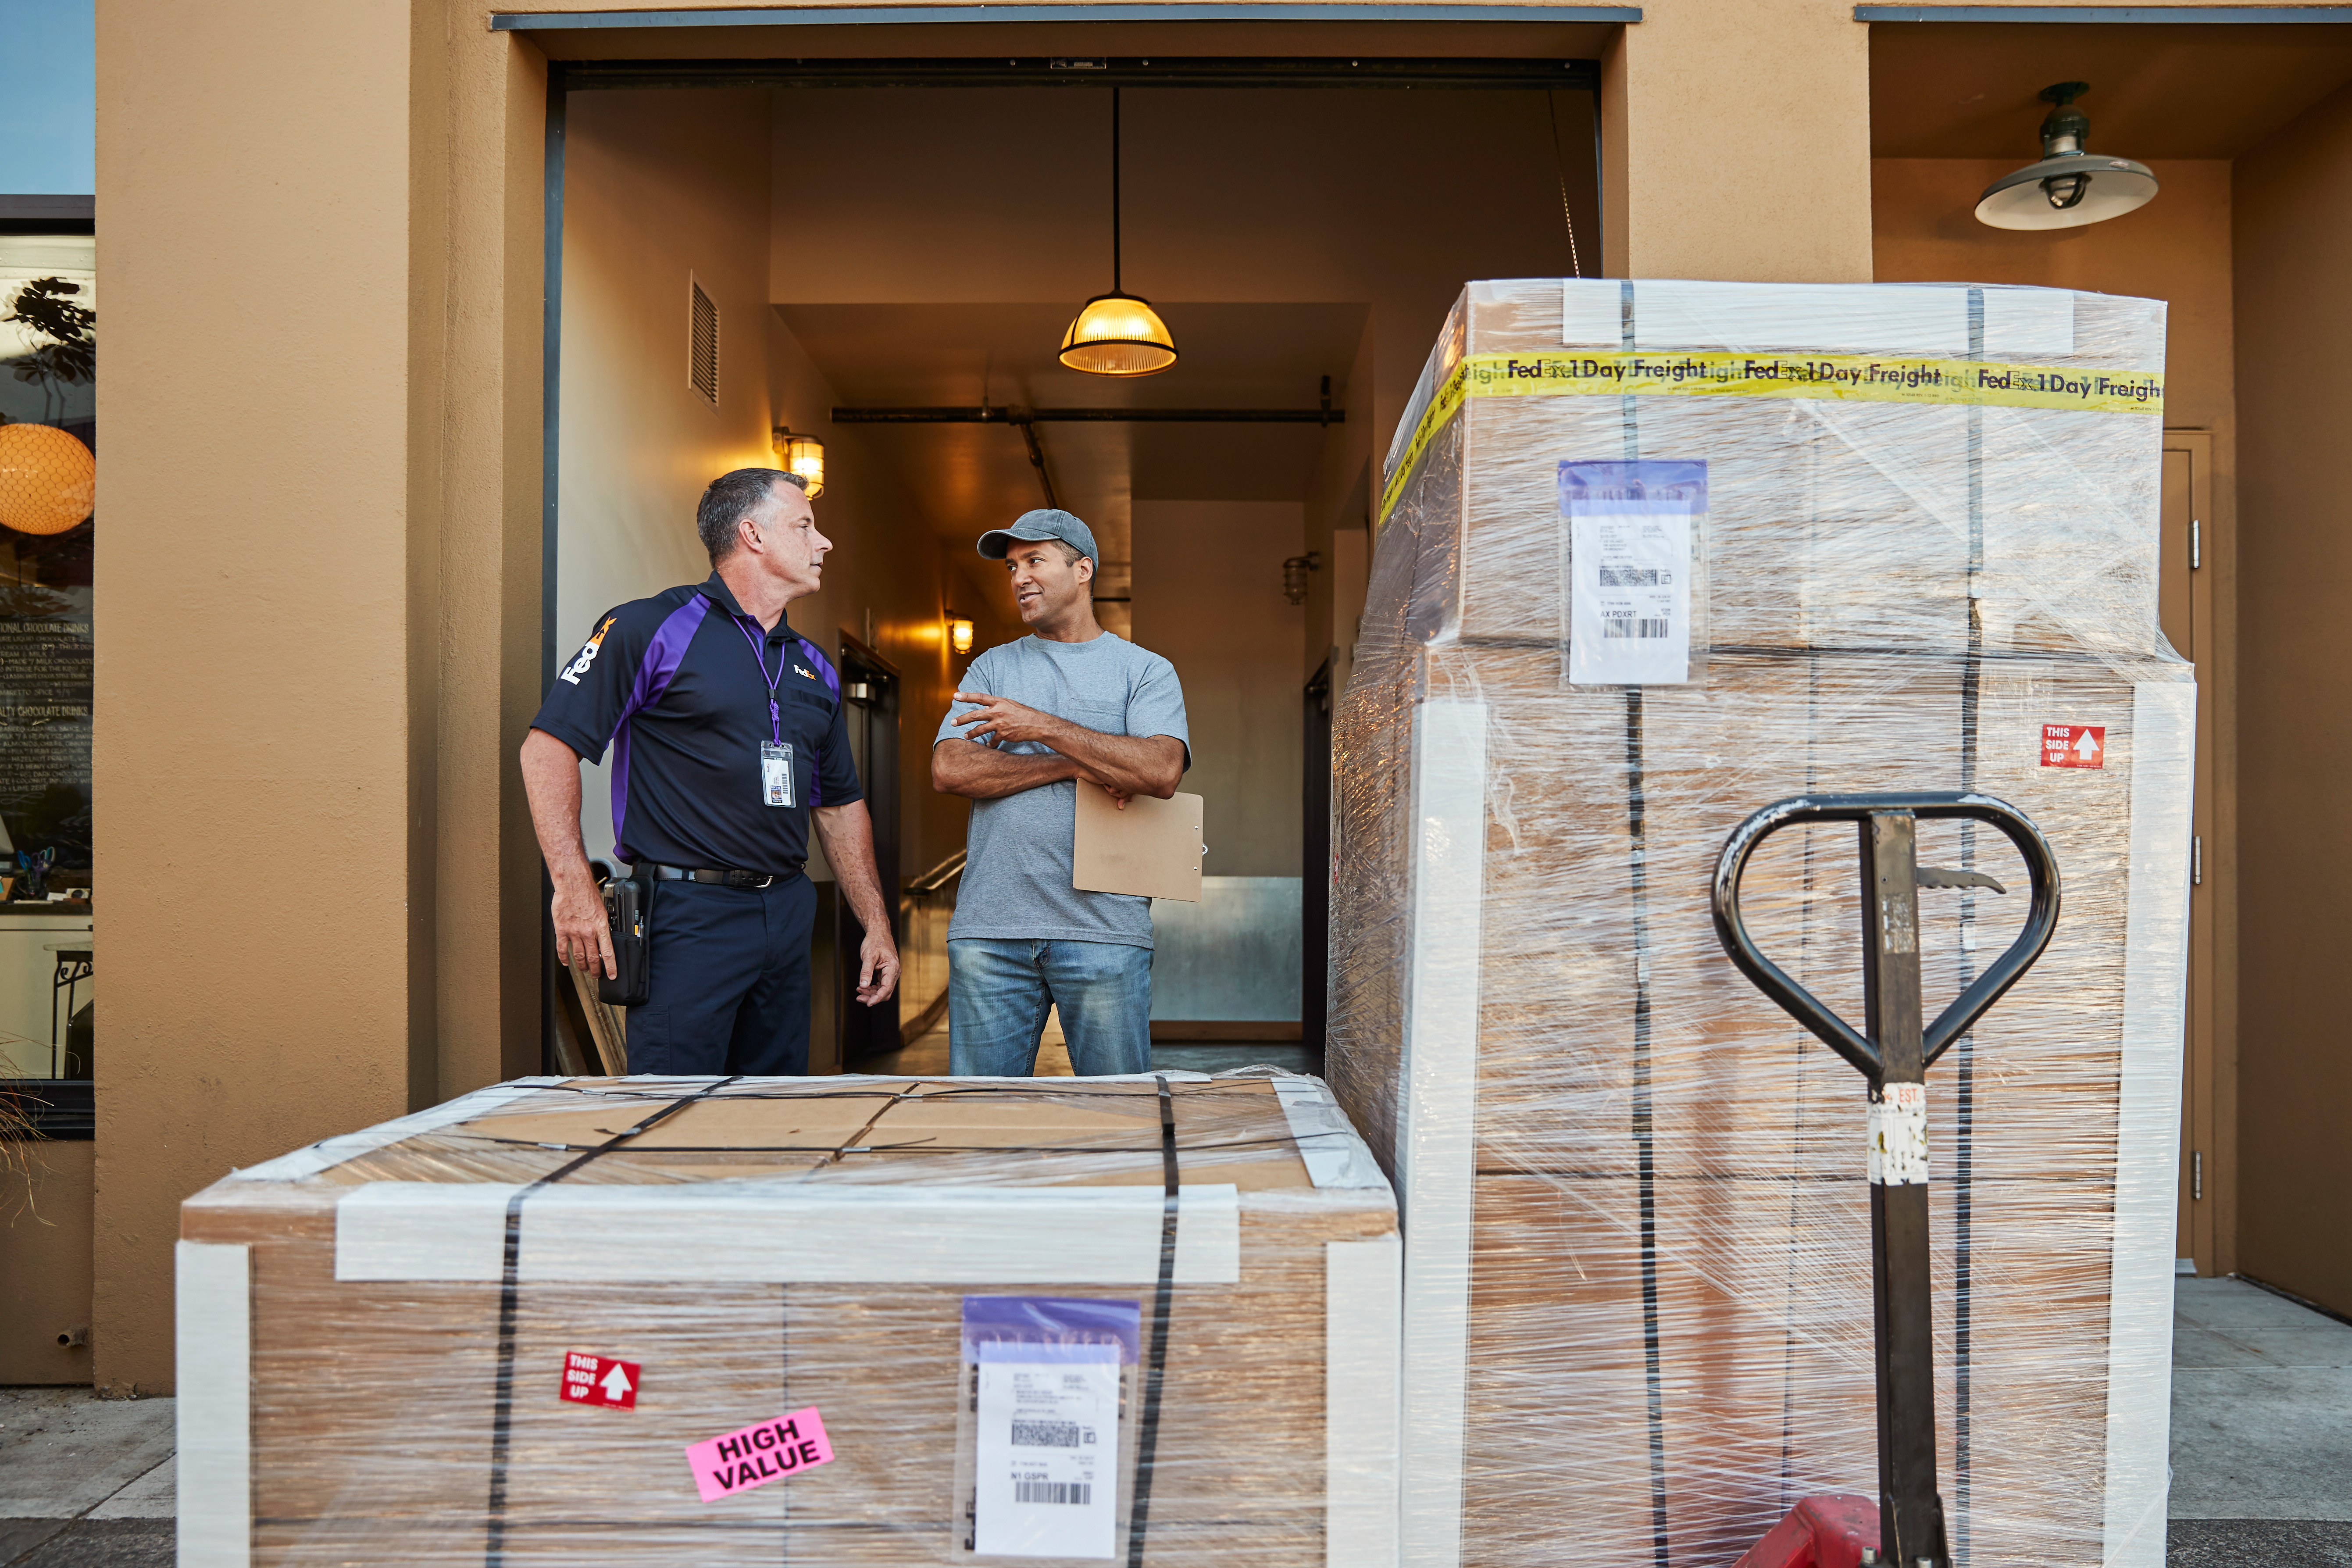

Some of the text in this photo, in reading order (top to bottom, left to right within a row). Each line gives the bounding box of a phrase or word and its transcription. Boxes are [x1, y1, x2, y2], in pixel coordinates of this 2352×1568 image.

[1635, 358, 1706, 382] Freight
[1870, 364, 1941, 388] Freight
[23, 623, 62, 633] CHOCOLATE
[63, 623, 89, 633] DRINKS
[560, 616, 617, 685] FedEx
[794, 664, 816, 681] FedEx
[18, 706, 61, 717] CHOCOLATE
[62, 706, 88, 717] DRINKS
[2047, 727, 2070, 737] THIS
[2045, 739, 2069, 750] SIDE
[2049, 752, 2064, 762] UP
[1899, 1088, 1920, 1102] EST.
[569, 1354, 598, 1372] THIS
[567, 1369, 596, 1386] SIDE
[569, 1384, 589, 1399] UP
[717, 1419, 801, 1463] HIGH
[713, 1439, 821, 1490] VALUE
